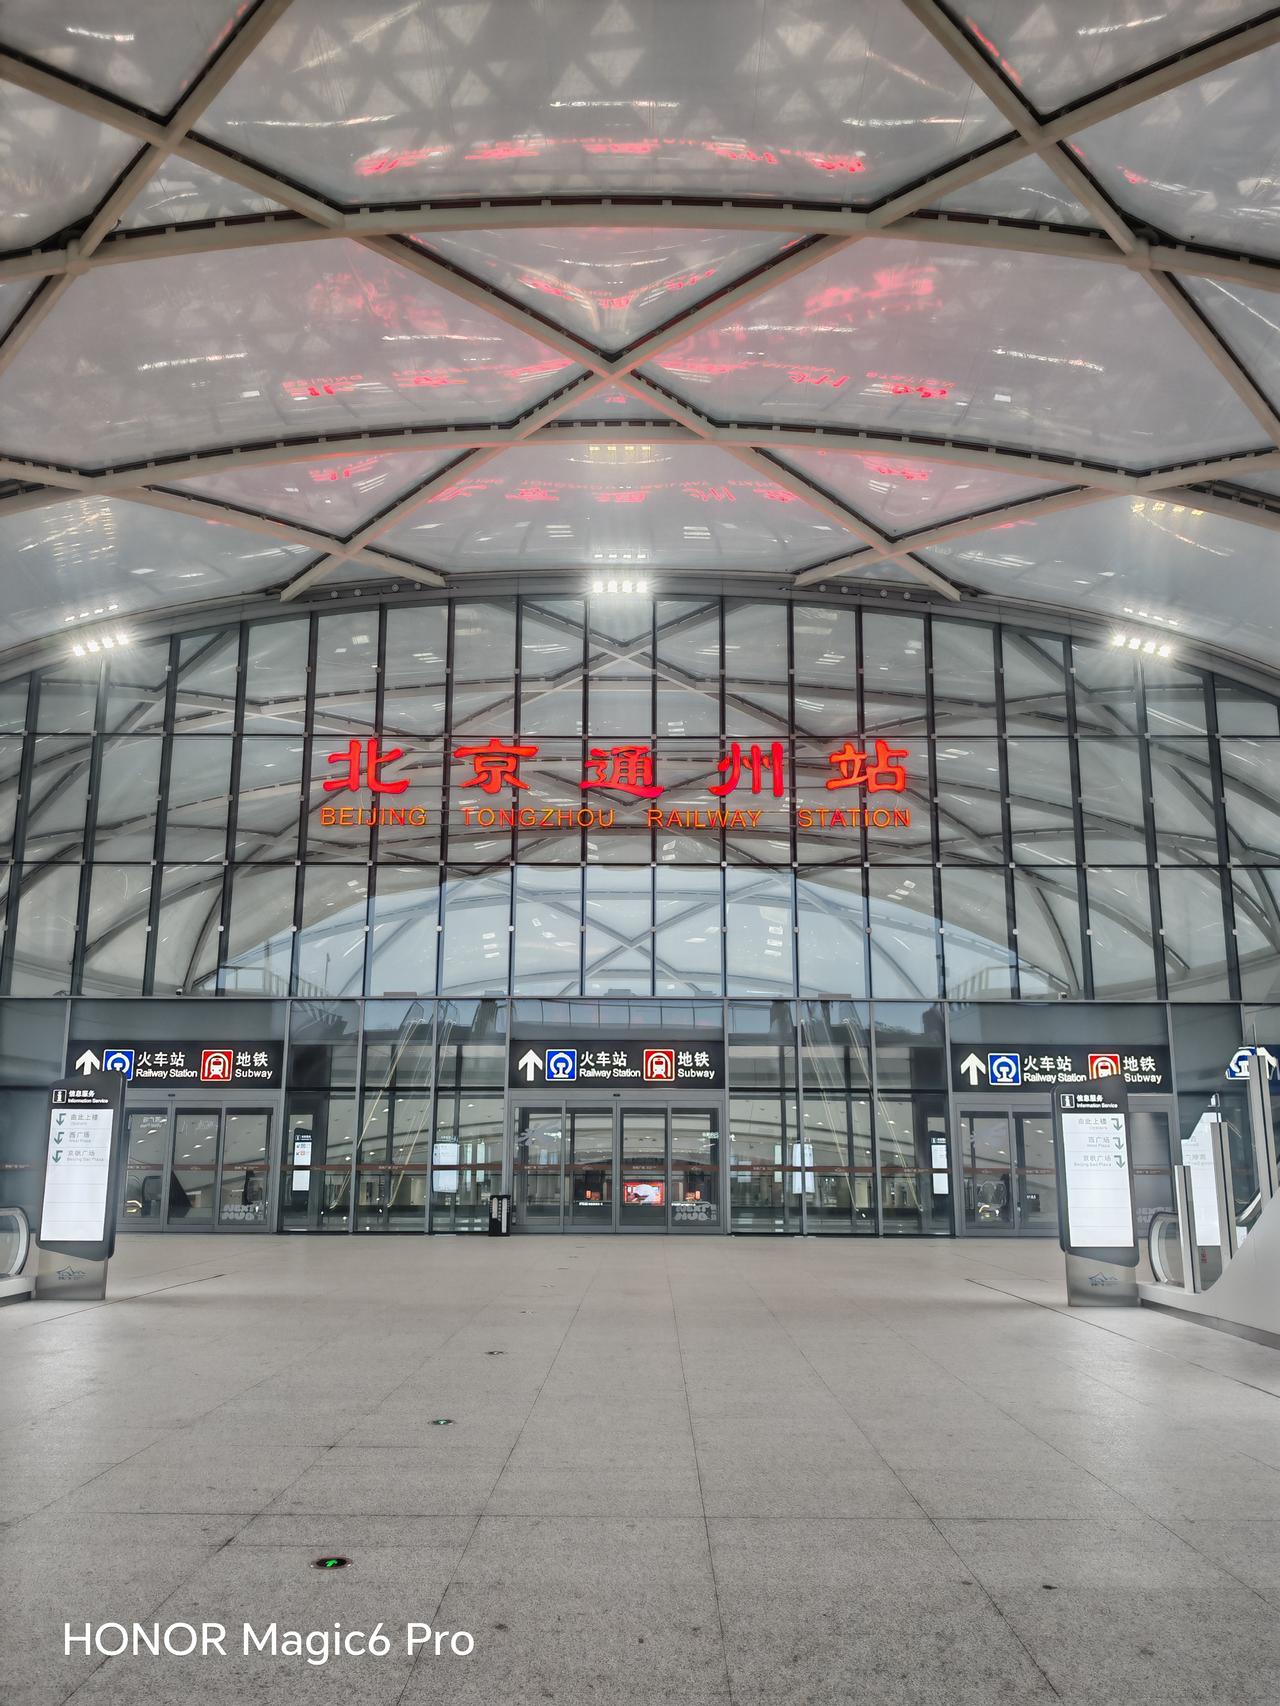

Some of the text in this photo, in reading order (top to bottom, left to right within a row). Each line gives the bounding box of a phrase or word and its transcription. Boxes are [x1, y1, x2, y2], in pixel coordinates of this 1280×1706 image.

[323, 738, 909, 798] 北京通州站
[320, 806, 911, 828] BEIJING TONGZHOU RAILWAY STATION
[138, 1052, 186, 1067] 火车站
[236, 1051, 269, 1067] 地铁
[579, 1051, 628, 1067] 火车站
[677, 1051, 710, 1067] 地铁
[1023, 1055, 1072, 1072] 火车站
[1123, 1055, 1156, 1072] 地铁
[136, 1069, 198, 1080] Railway Station
[234, 1069, 273, 1080] Subway
[579, 1068, 641, 1079] Railway Station
[677, 1069, 715, 1080] Subway
[1023, 1073, 1087, 1084] Railway Station
[1124, 1073, 1162, 1084] Subway
[68, 1089, 96, 1097] 信息服务
[1076, 1094, 1104, 1102] 信息服务
